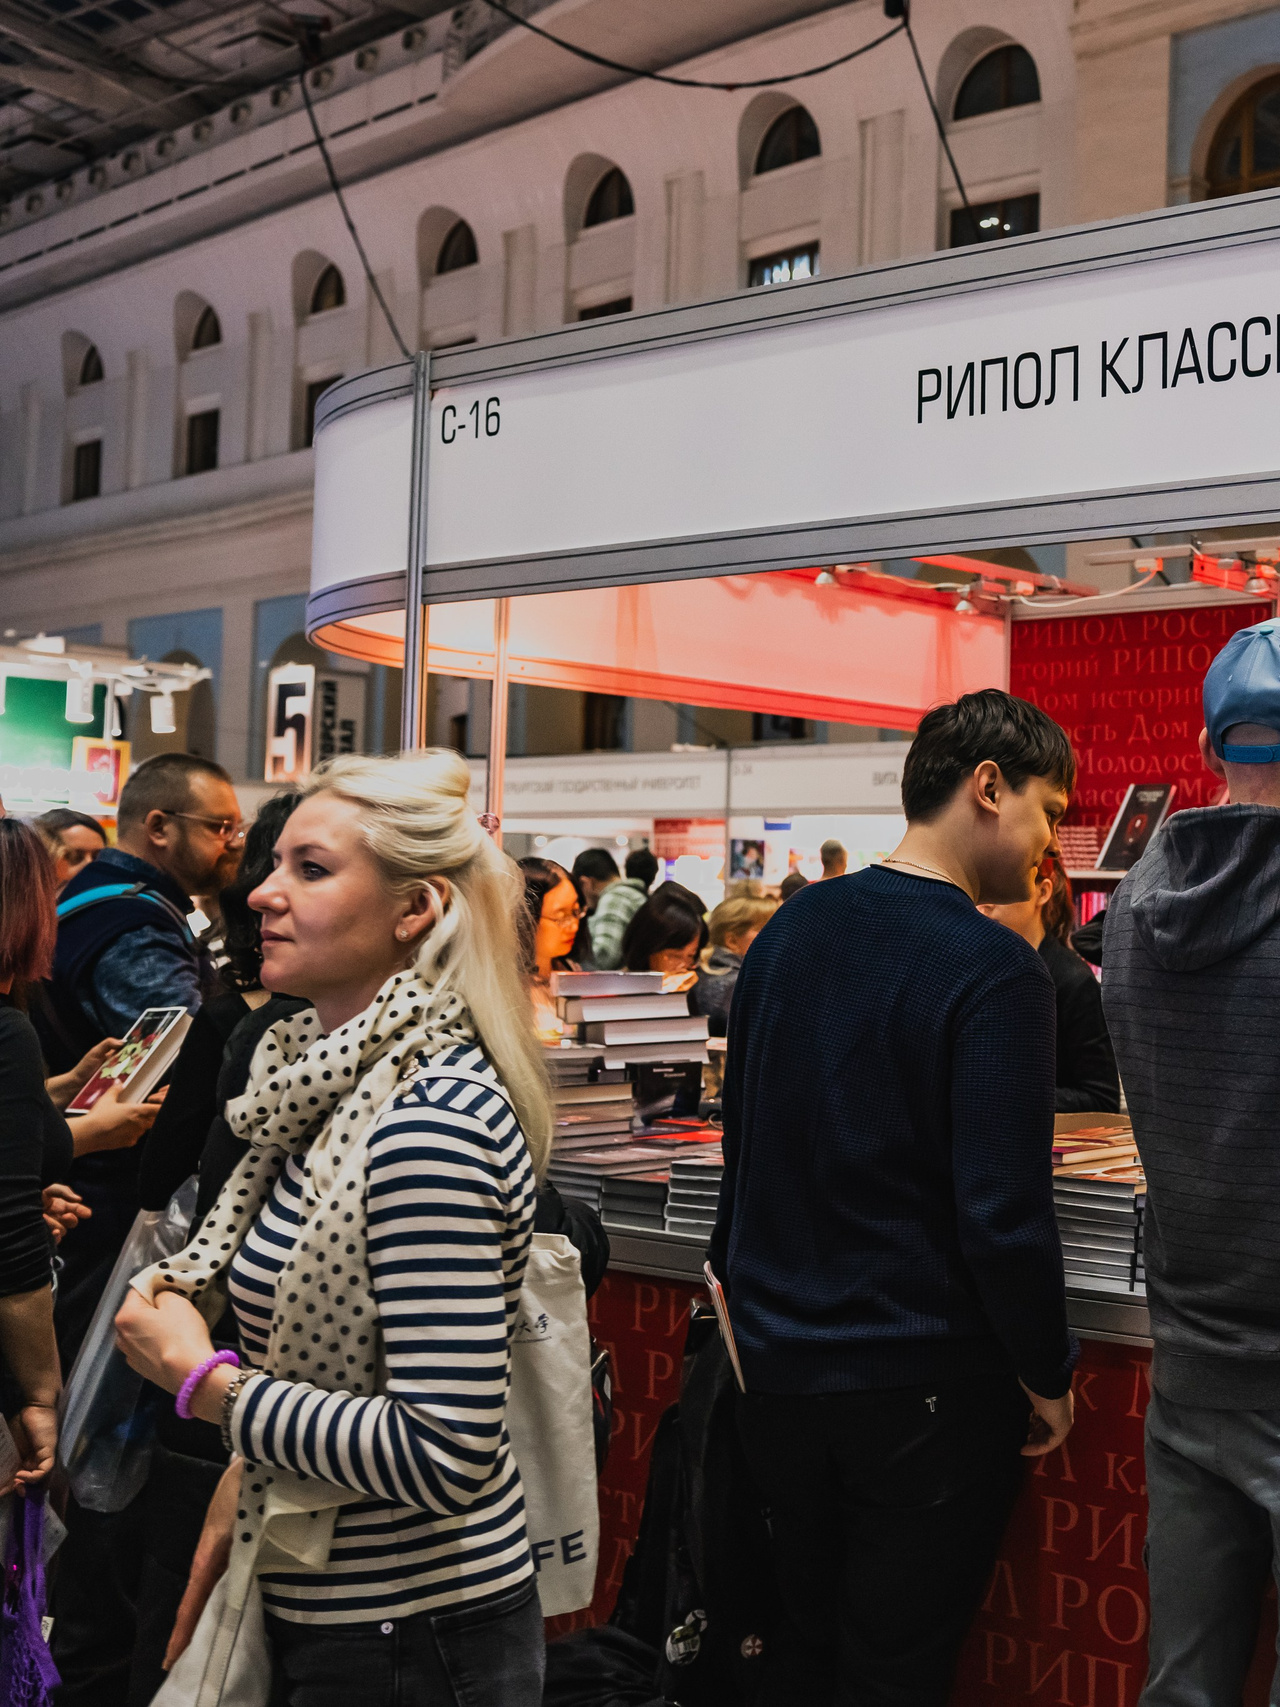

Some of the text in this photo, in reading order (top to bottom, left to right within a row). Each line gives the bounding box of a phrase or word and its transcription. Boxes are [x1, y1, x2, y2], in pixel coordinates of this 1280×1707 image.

[917, 344, 1079, 424] РИПОЛ
[441, 396, 501, 445] С-16
[1013, 616, 1128, 649] РИПОЛ
[1141, 608, 1235, 641] РОСТ
[1113, 642, 1226, 676] РИПО
[1091, 685, 1204, 714] истори
[1128, 714, 1189, 745] Дом
